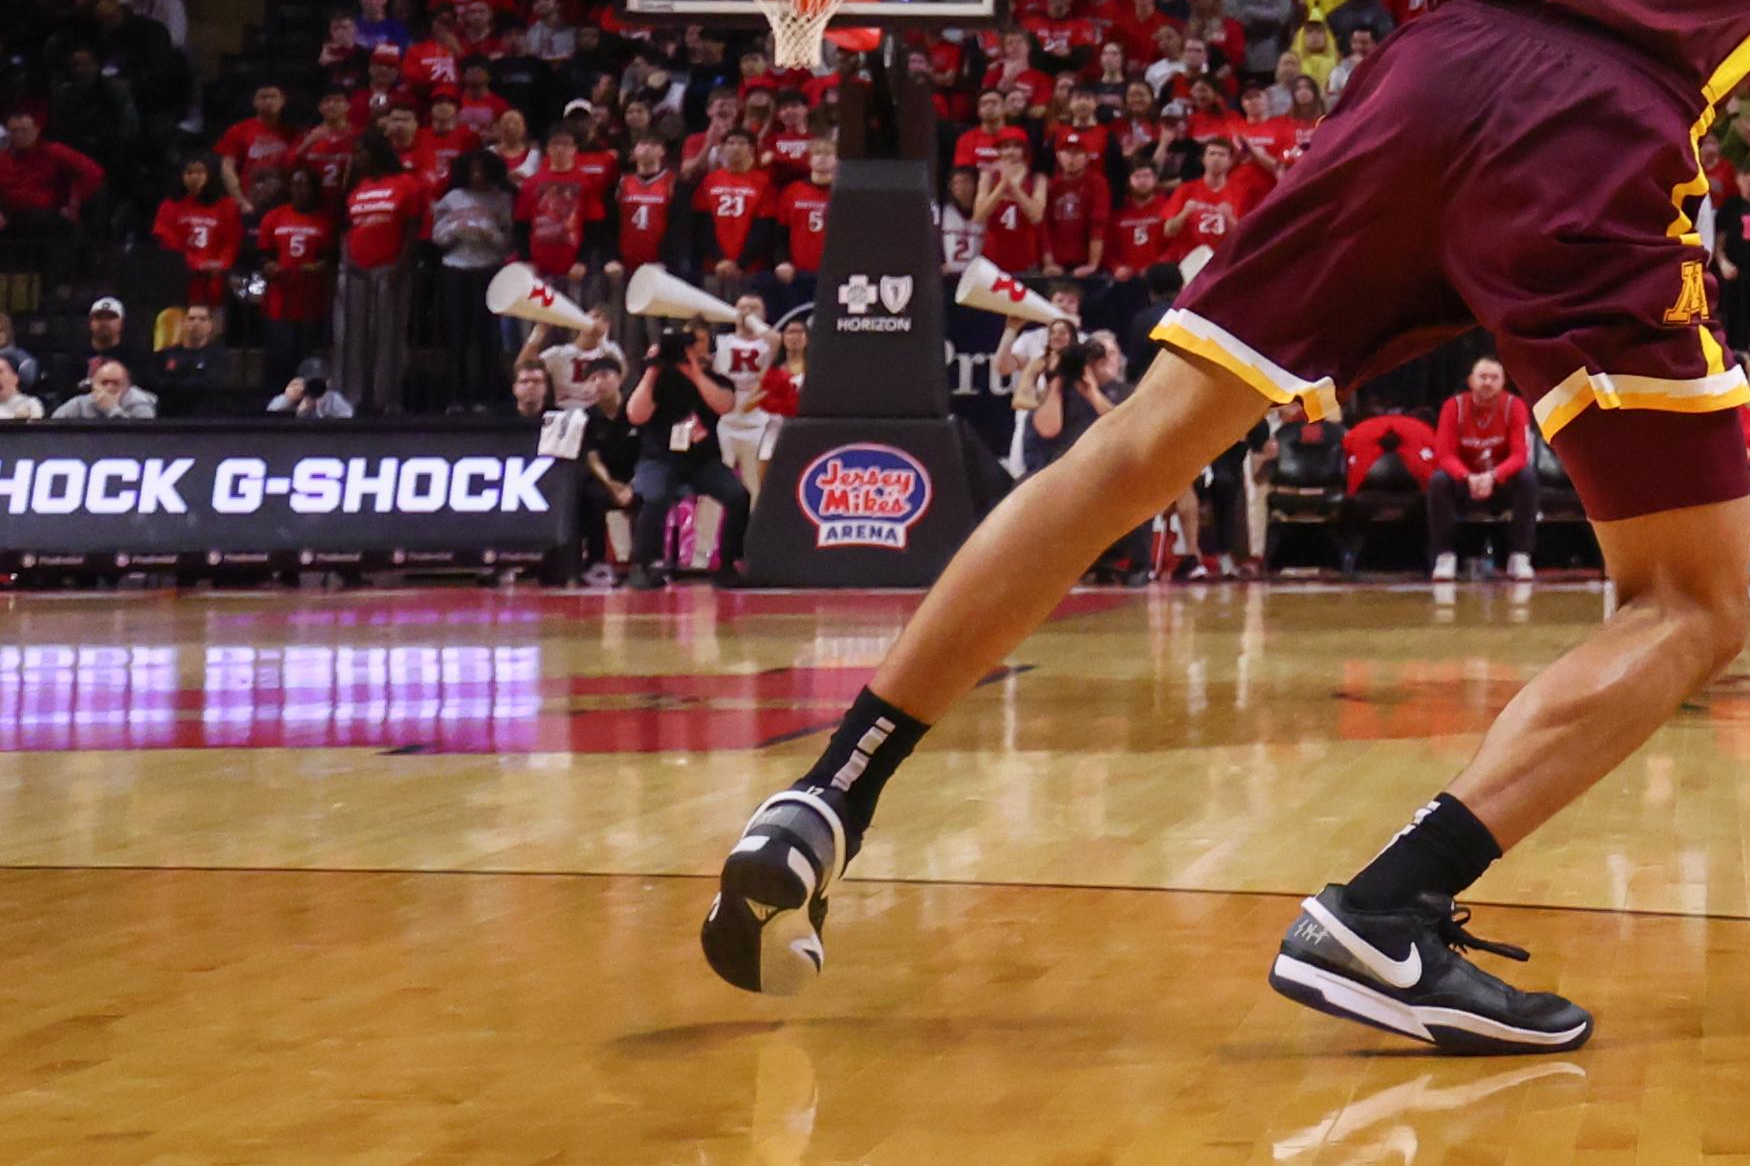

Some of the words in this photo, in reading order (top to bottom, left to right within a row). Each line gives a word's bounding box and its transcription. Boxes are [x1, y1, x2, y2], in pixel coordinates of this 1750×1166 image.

[631, 205, 649, 231] 4
[1000, 204, 1018, 231] 4
[837, 317, 912, 332] HORIZON
[731, 348, 760, 373] R
[212, 457, 555, 513] G-SHOCK
[817, 460, 915, 495] Jersey
[826, 525, 898, 542] ARENA
